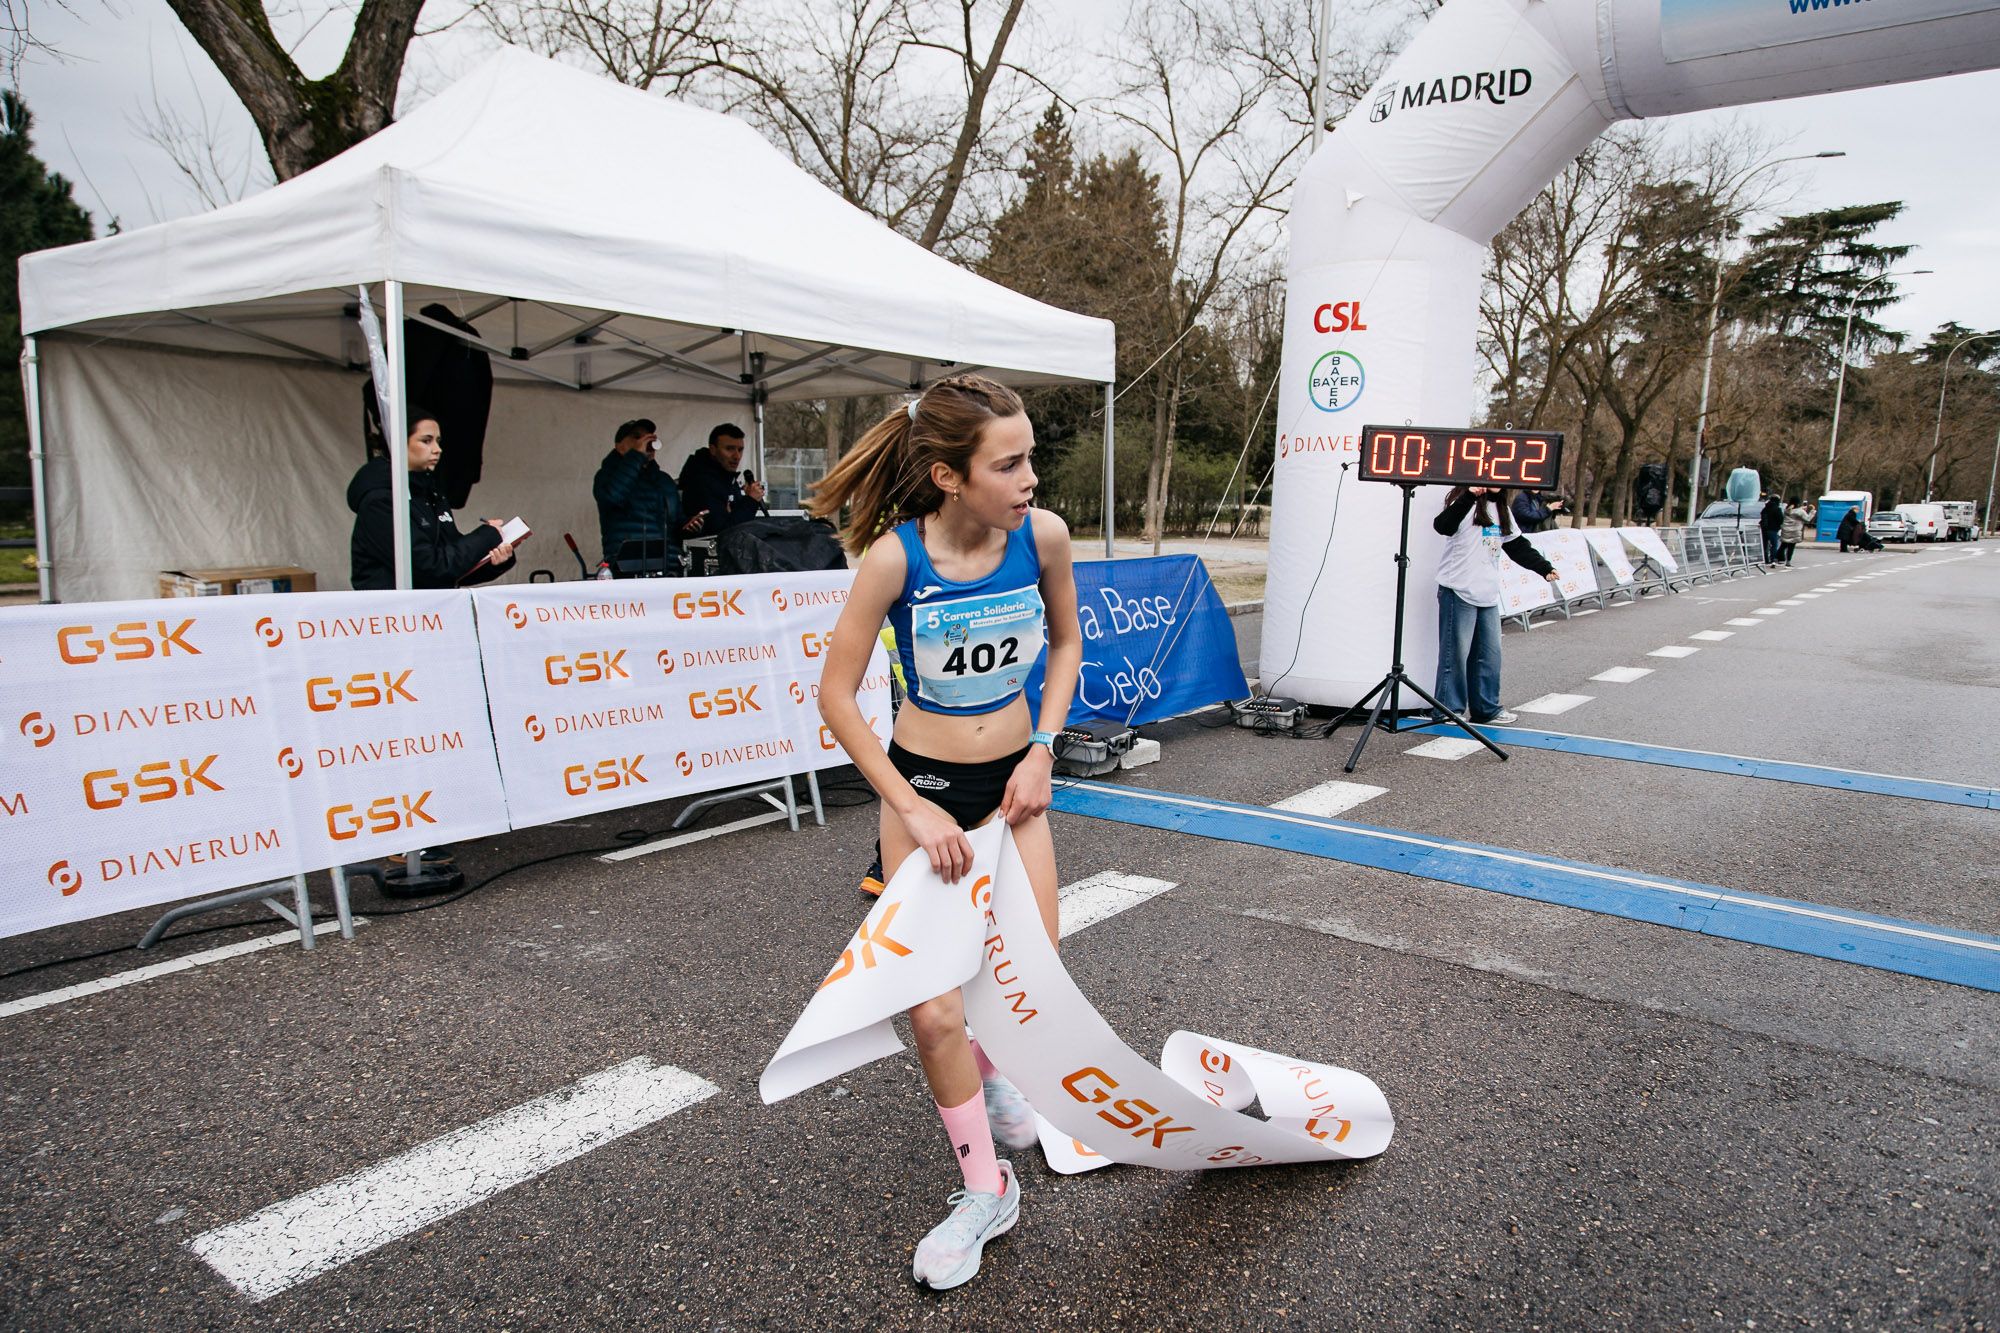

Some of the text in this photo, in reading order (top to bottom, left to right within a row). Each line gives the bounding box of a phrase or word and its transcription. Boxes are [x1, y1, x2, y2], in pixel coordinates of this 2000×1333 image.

[1401, 69, 1532, 110] MADRID
[1314, 301, 1368, 334] CSL
[1313, 376, 1360, 388] BAYER
[1329, 356, 1341, 407] BAYER
[1294, 435, 1362, 453] DIAVE
[1371, 434, 1547, 481] 00:19:22
[537, 602, 647, 624] DIAVERUM
[672, 588, 746, 620] GSK
[794, 590, 849, 607] DIAVER
[943, 610, 981, 622] Carrera
[983, 601, 1025, 617] Solidaria
[1100, 587, 1176, 635] Base
[57, 618, 202, 665] GSK
[297, 613, 444, 640] DIAVERUM
[545, 649, 630, 686] GSK
[684, 645, 777, 667] DIAVERUM
[942, 637, 1019, 676] 402
[306, 669, 418, 712] GSK
[1078, 656, 1162, 710] Cielo
[74, 696, 257, 736] DIAVERUM
[555, 704, 664, 734] DIAVERUM
[689, 685, 762, 720] GSK
[318, 731, 464, 769] DIAVERUM
[702, 739, 795, 769] DIAVERUM
[83, 754, 225, 811] GSK
[564, 754, 649, 796] GSK
[326, 790, 437, 841] GSK
[101, 828, 281, 882] DIAVERUM
[1061, 1066, 1197, 1149] GSK
